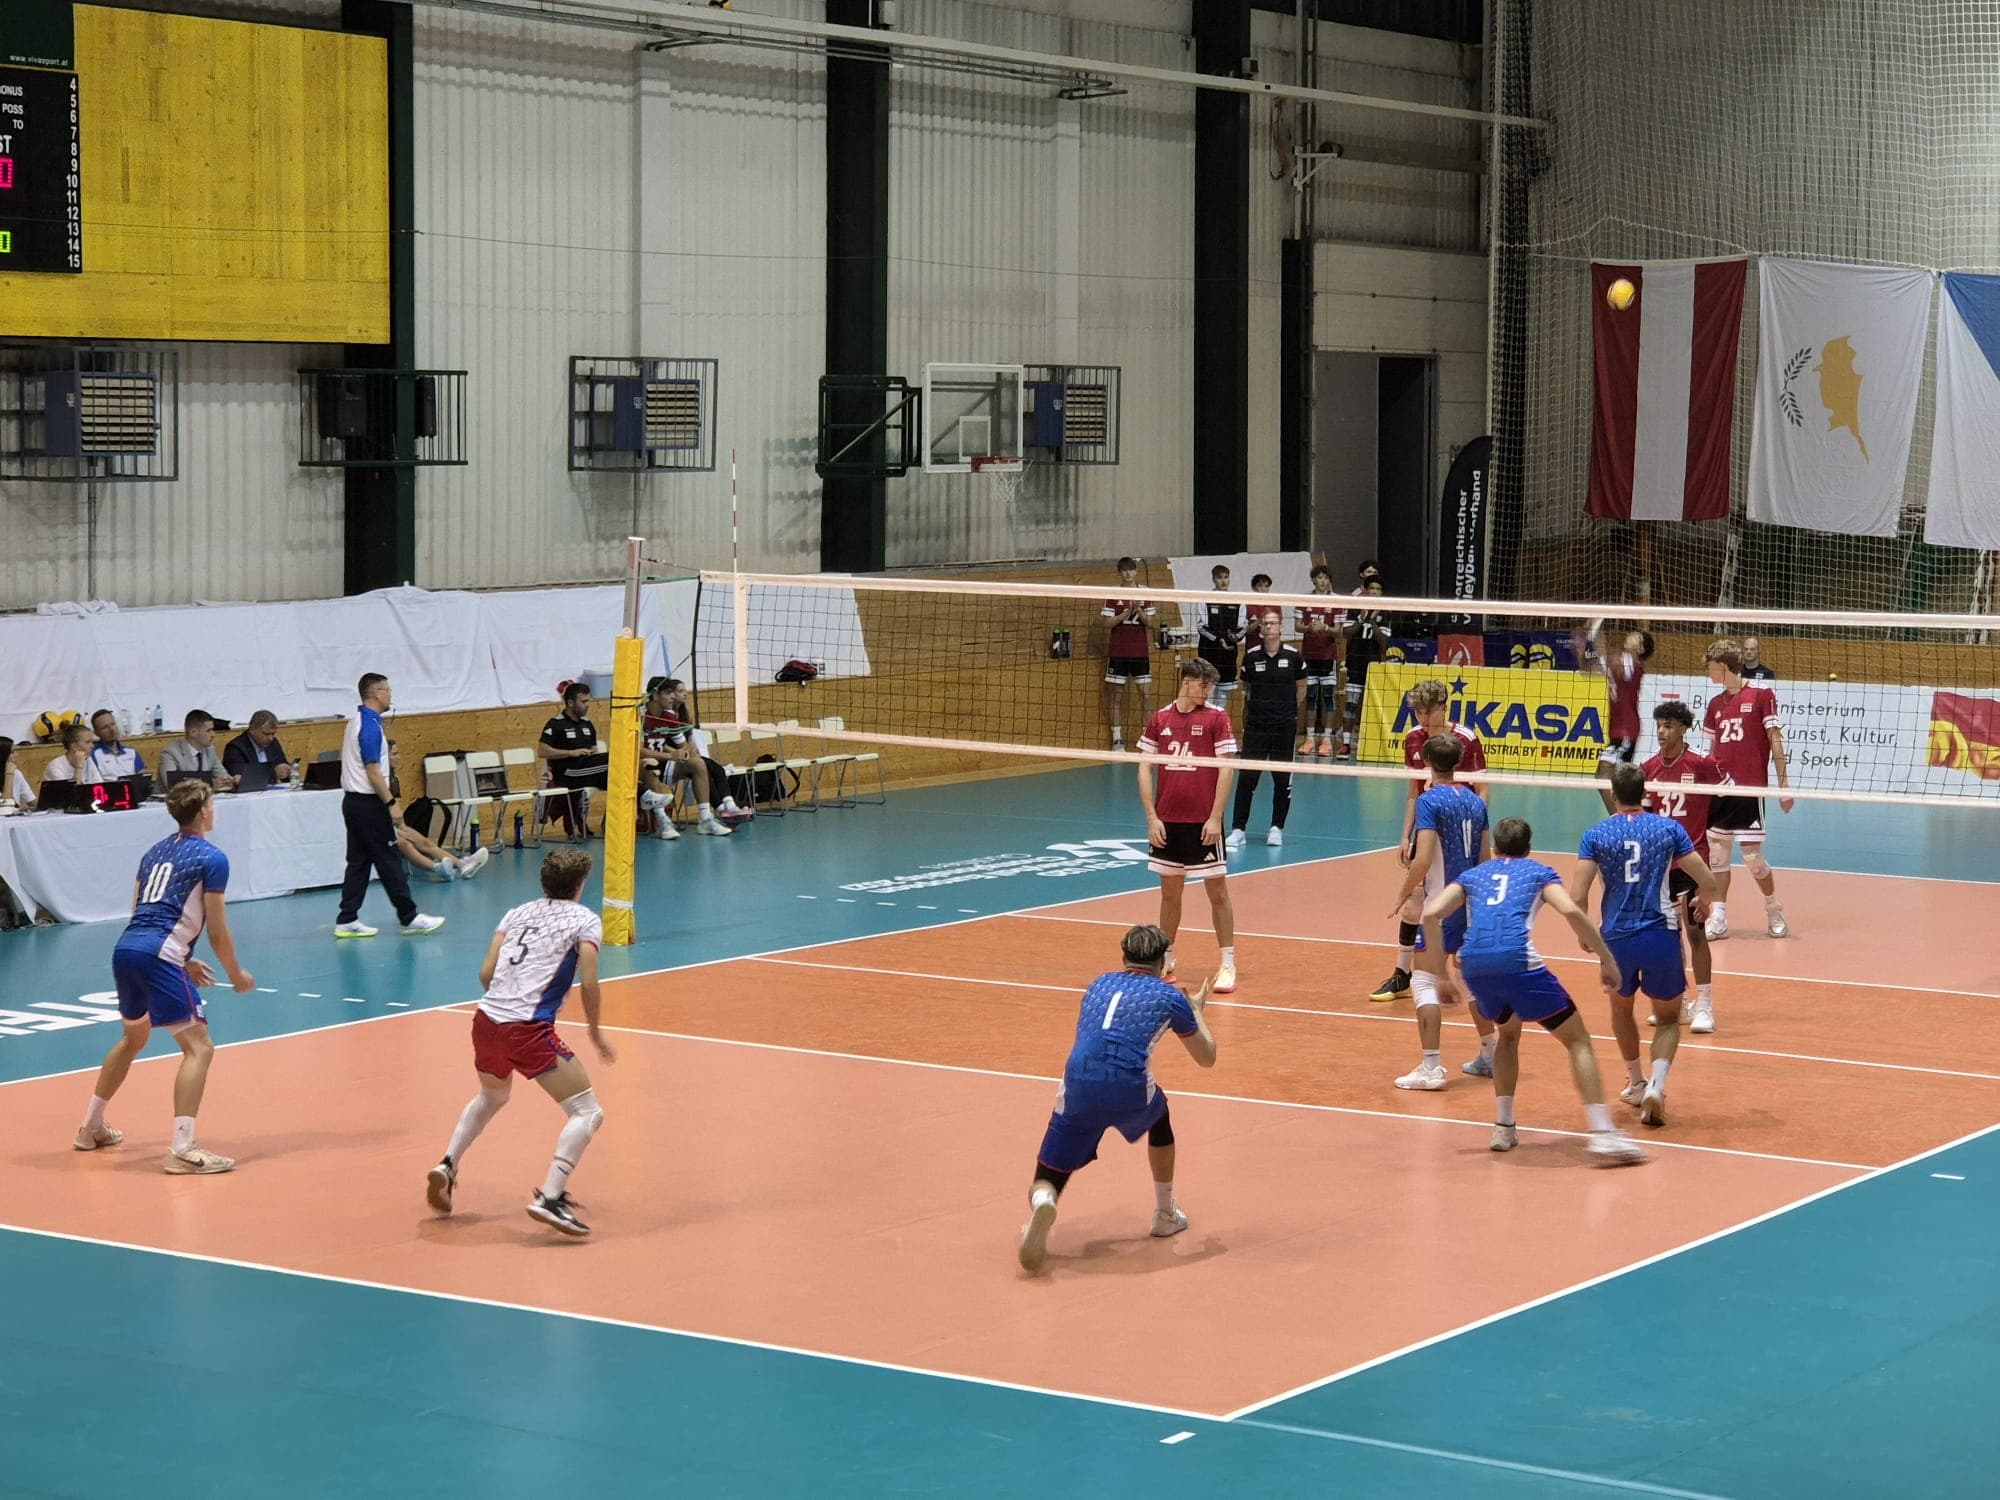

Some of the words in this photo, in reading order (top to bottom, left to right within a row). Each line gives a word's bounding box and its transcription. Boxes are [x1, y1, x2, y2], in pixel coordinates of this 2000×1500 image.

[69, 77, 77, 91] 4
[70, 94, 77, 108] 5
[2, 102, 24, 115] POSS
[70, 110, 77, 123] 6
[12, 118, 24, 130] TO
[70, 126, 77, 140] 7
[70, 142, 77, 156] 8
[70, 158, 78, 172] 9
[66, 174, 78, 188] 10
[66, 190, 78, 204] 11
[66, 206, 79, 220] 12
[67, 222, 79, 236] 13
[67, 238, 80, 252] 14
[67, 254, 80, 268] 15
[1719, 717, 1744, 744] 23
[1839, 726, 1898, 747] Kultur,
[1481, 744, 1523, 757] USTRIA
[1523, 746, 1537, 758] BY
[1799, 750, 1851, 770] Sport
[1656, 791, 1688, 818] 32
[1623, 840, 1641, 884] 2
[141, 862, 174, 904] 10
[1486, 874, 1509, 906] 3
[509, 926, 540, 966] 5
[1101, 990, 1124, 1031] 1
